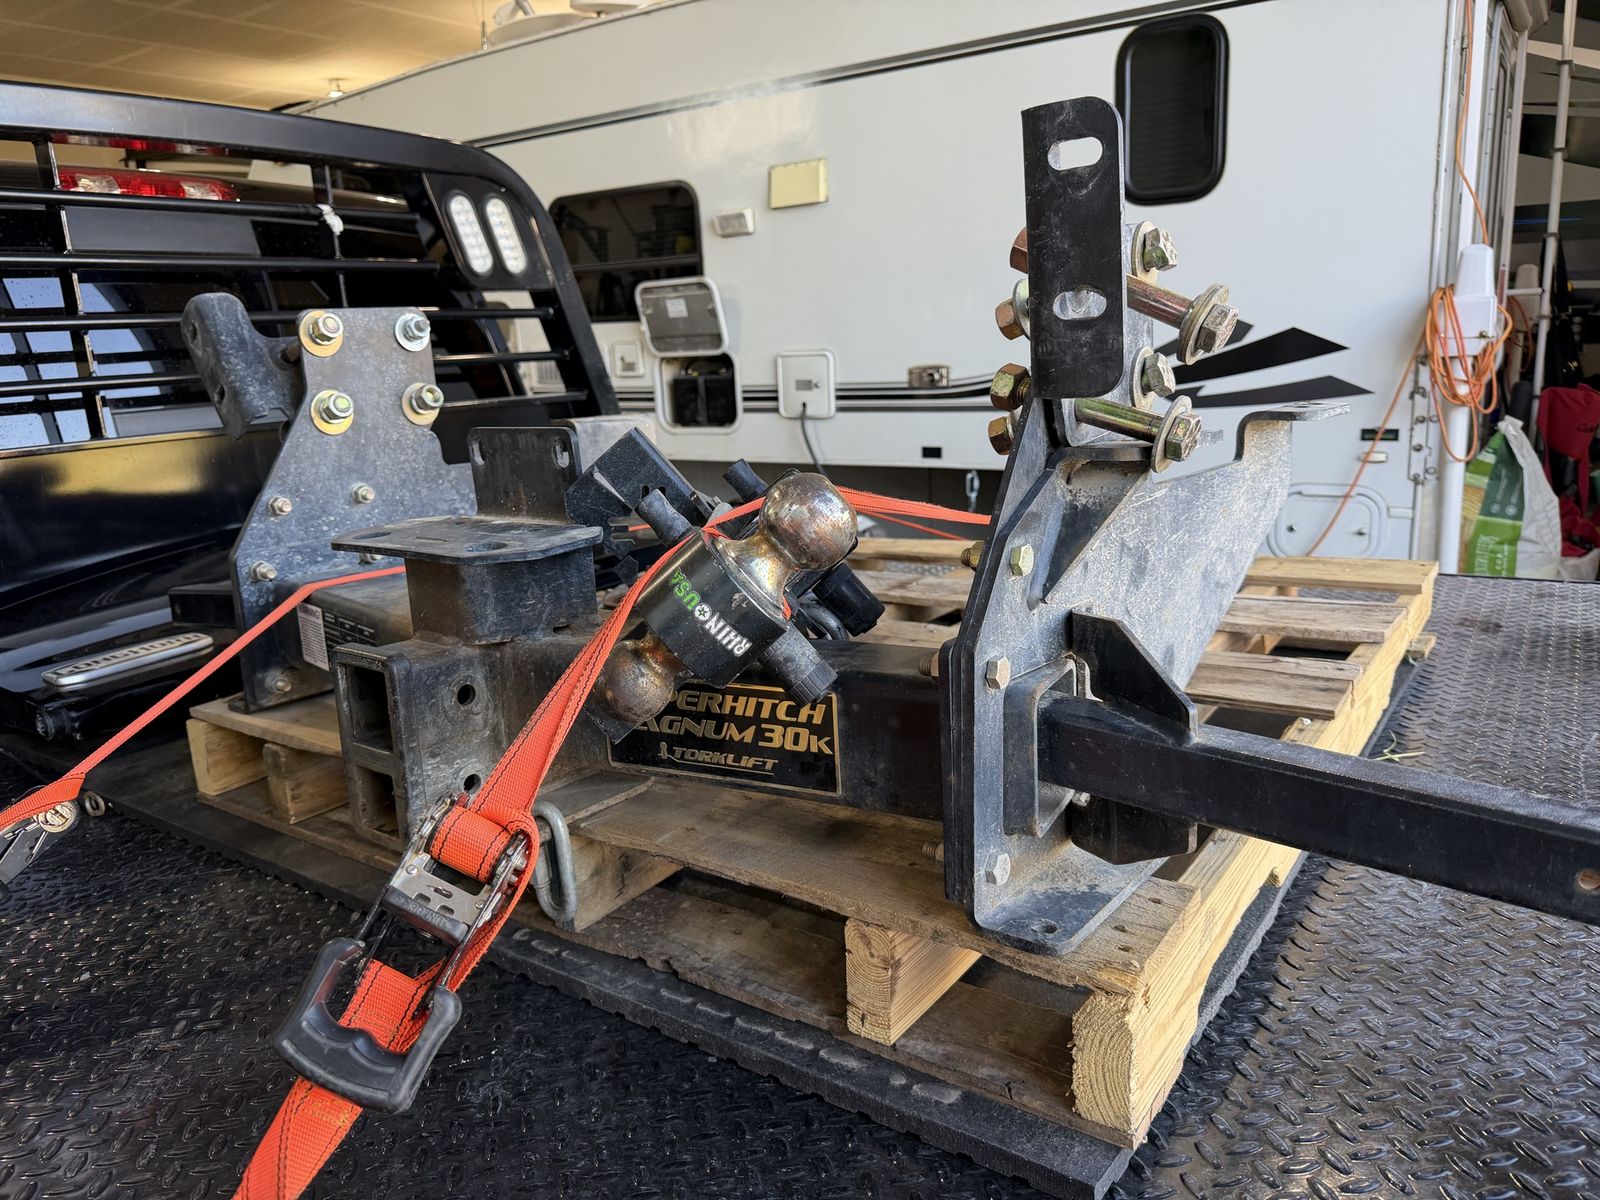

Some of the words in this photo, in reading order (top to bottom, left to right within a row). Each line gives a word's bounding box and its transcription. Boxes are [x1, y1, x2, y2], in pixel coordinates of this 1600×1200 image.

[668, 567, 700, 611] USA
[694, 603, 753, 657] RHINO
[638, 715, 756, 743] AGNUM
[673, 746, 779, 771] TORKLIFT
